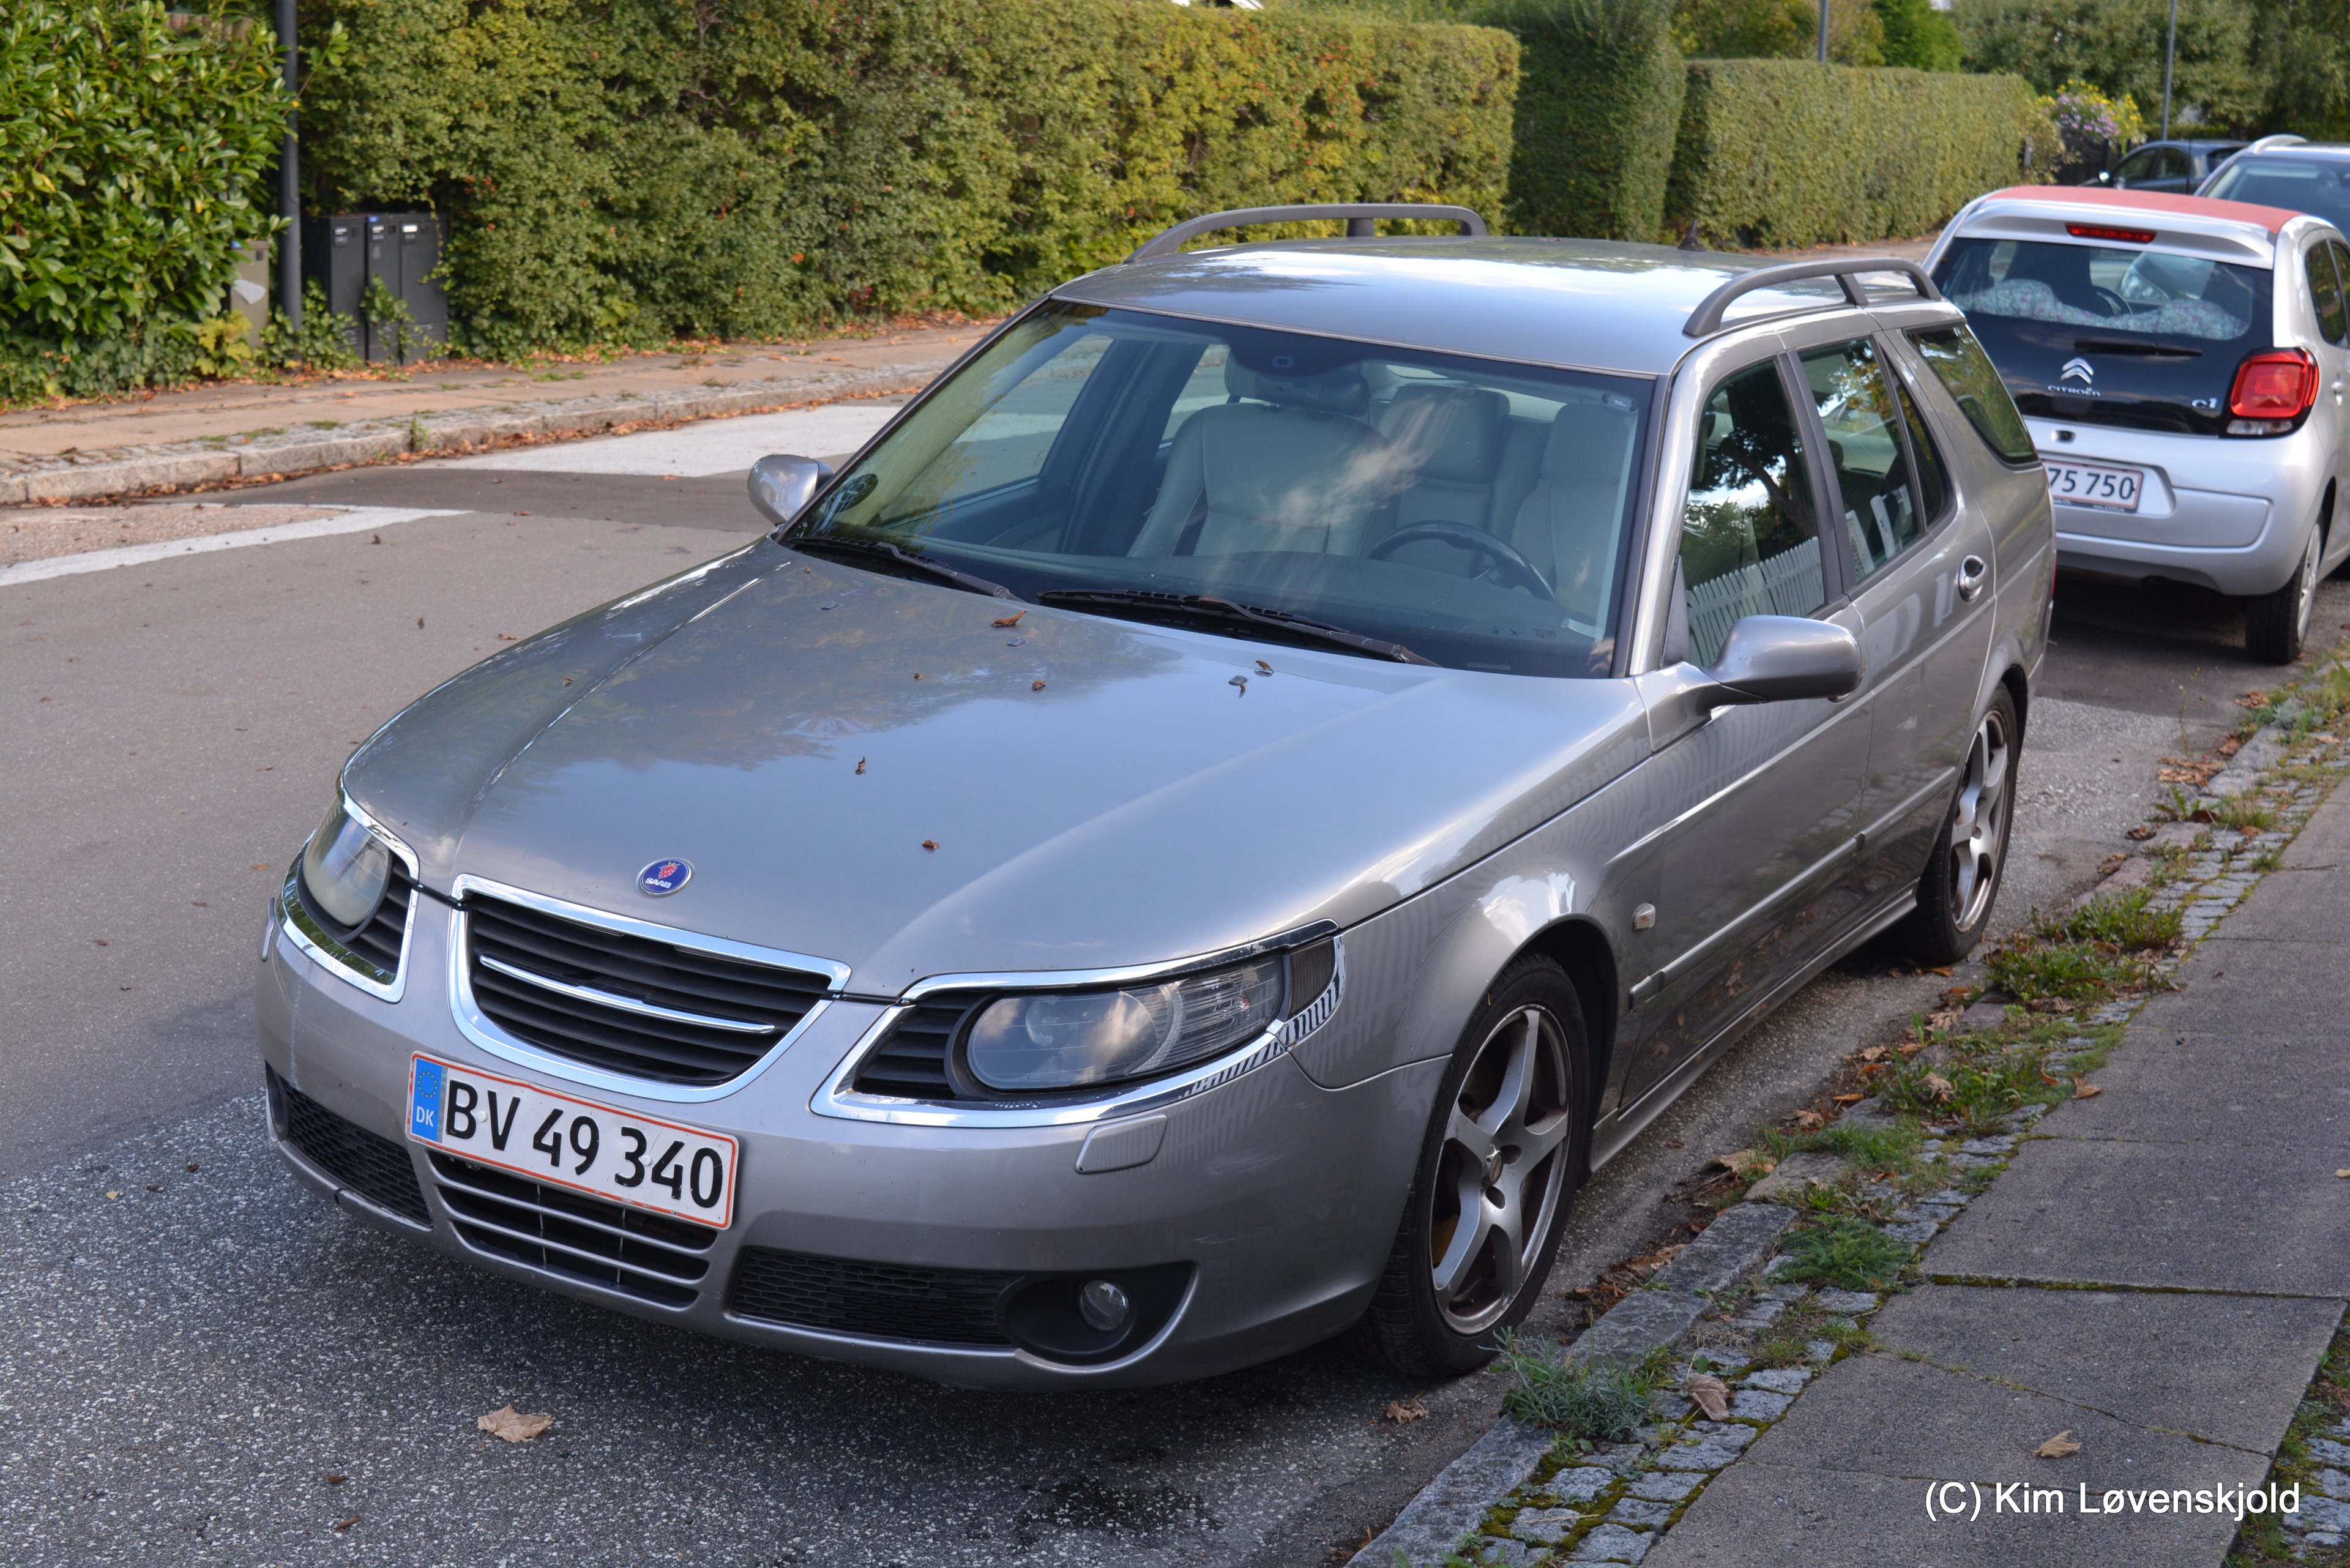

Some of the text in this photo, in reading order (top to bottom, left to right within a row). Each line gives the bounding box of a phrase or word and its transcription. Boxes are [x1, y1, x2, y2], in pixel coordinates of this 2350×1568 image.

[2048, 468, 2134, 500] 75 750
[645, 878, 672, 889] SAAB
[416, 1105, 435, 1127] DK
[446, 1078, 723, 1208] BV 49 340
